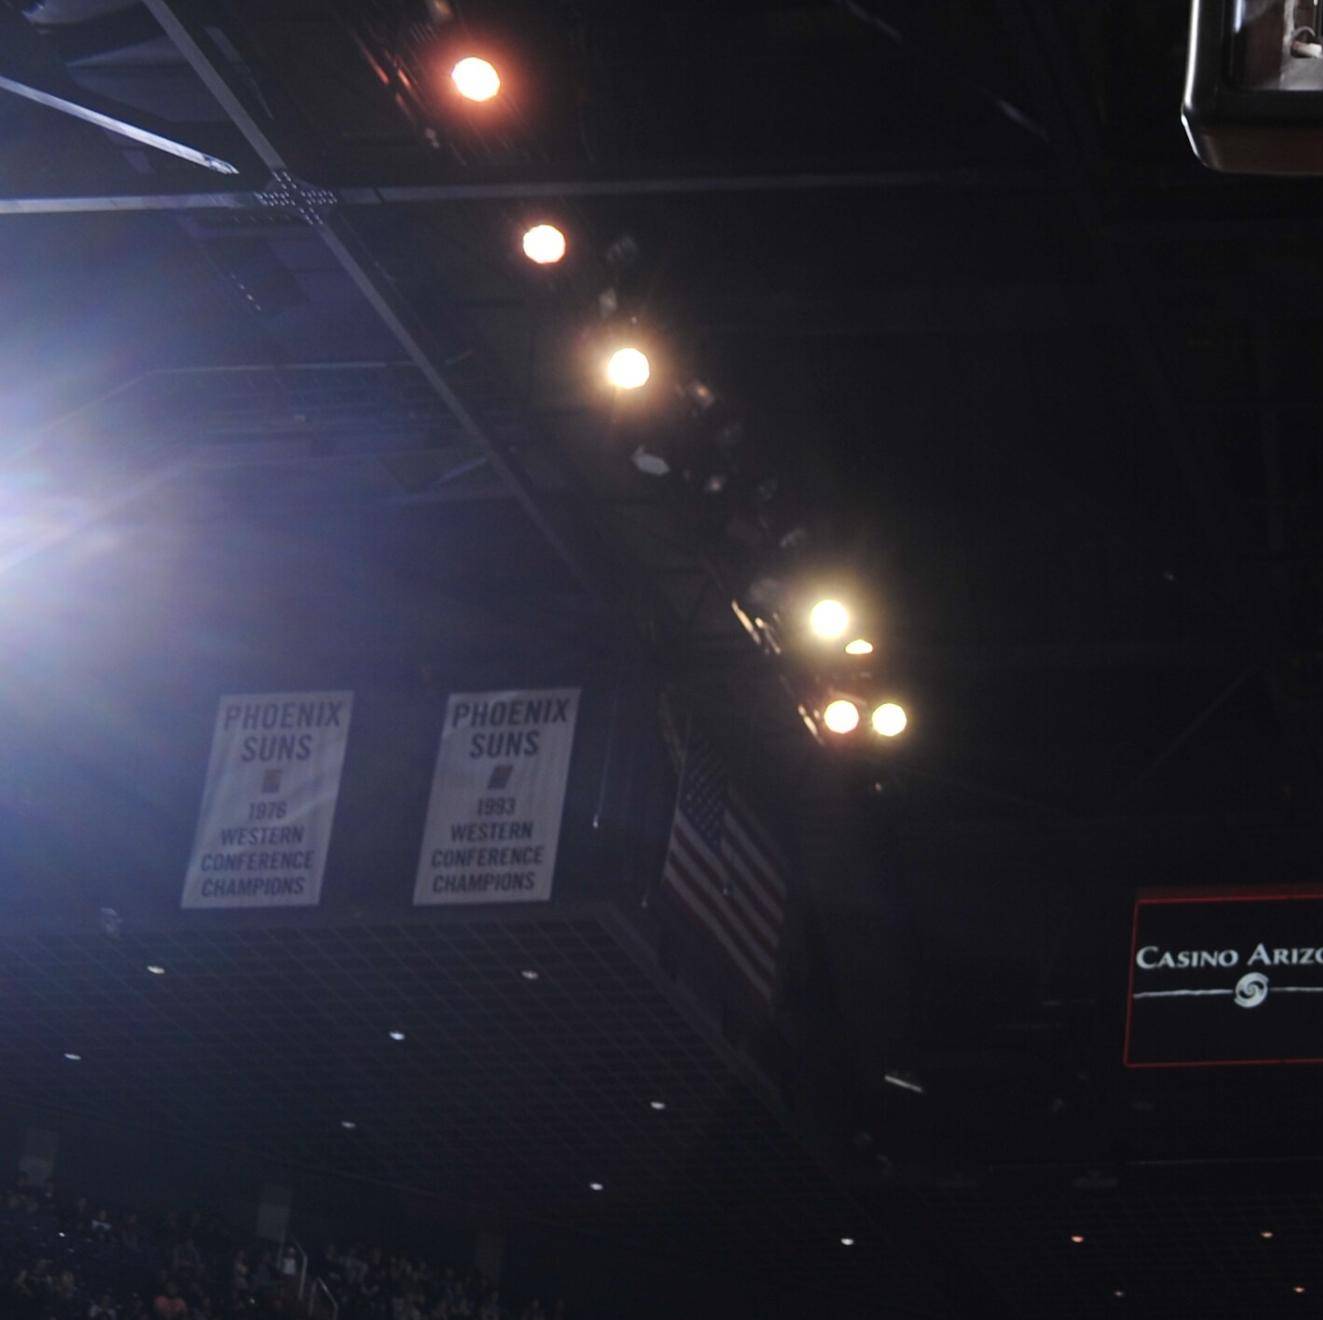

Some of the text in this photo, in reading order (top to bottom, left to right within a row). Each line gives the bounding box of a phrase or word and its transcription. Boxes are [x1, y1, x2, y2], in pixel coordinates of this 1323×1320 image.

[223, 700, 343, 731] PHOENIX
[451, 697, 572, 729] PHOENIX
[241, 734, 313, 763] SUNS
[469, 729, 541, 759] SUNS
[221, 824, 305, 847] WESTERN
[450, 821, 534, 843] WESTERN
[201, 850, 316, 872] CONFERENCE
[430, 845, 545, 868] CONFERENCE
[201, 876, 307, 898] CHAMPIONS
[431, 871, 536, 894] CHAMPIONS
[1136, 945, 1239, 970] CASINO
